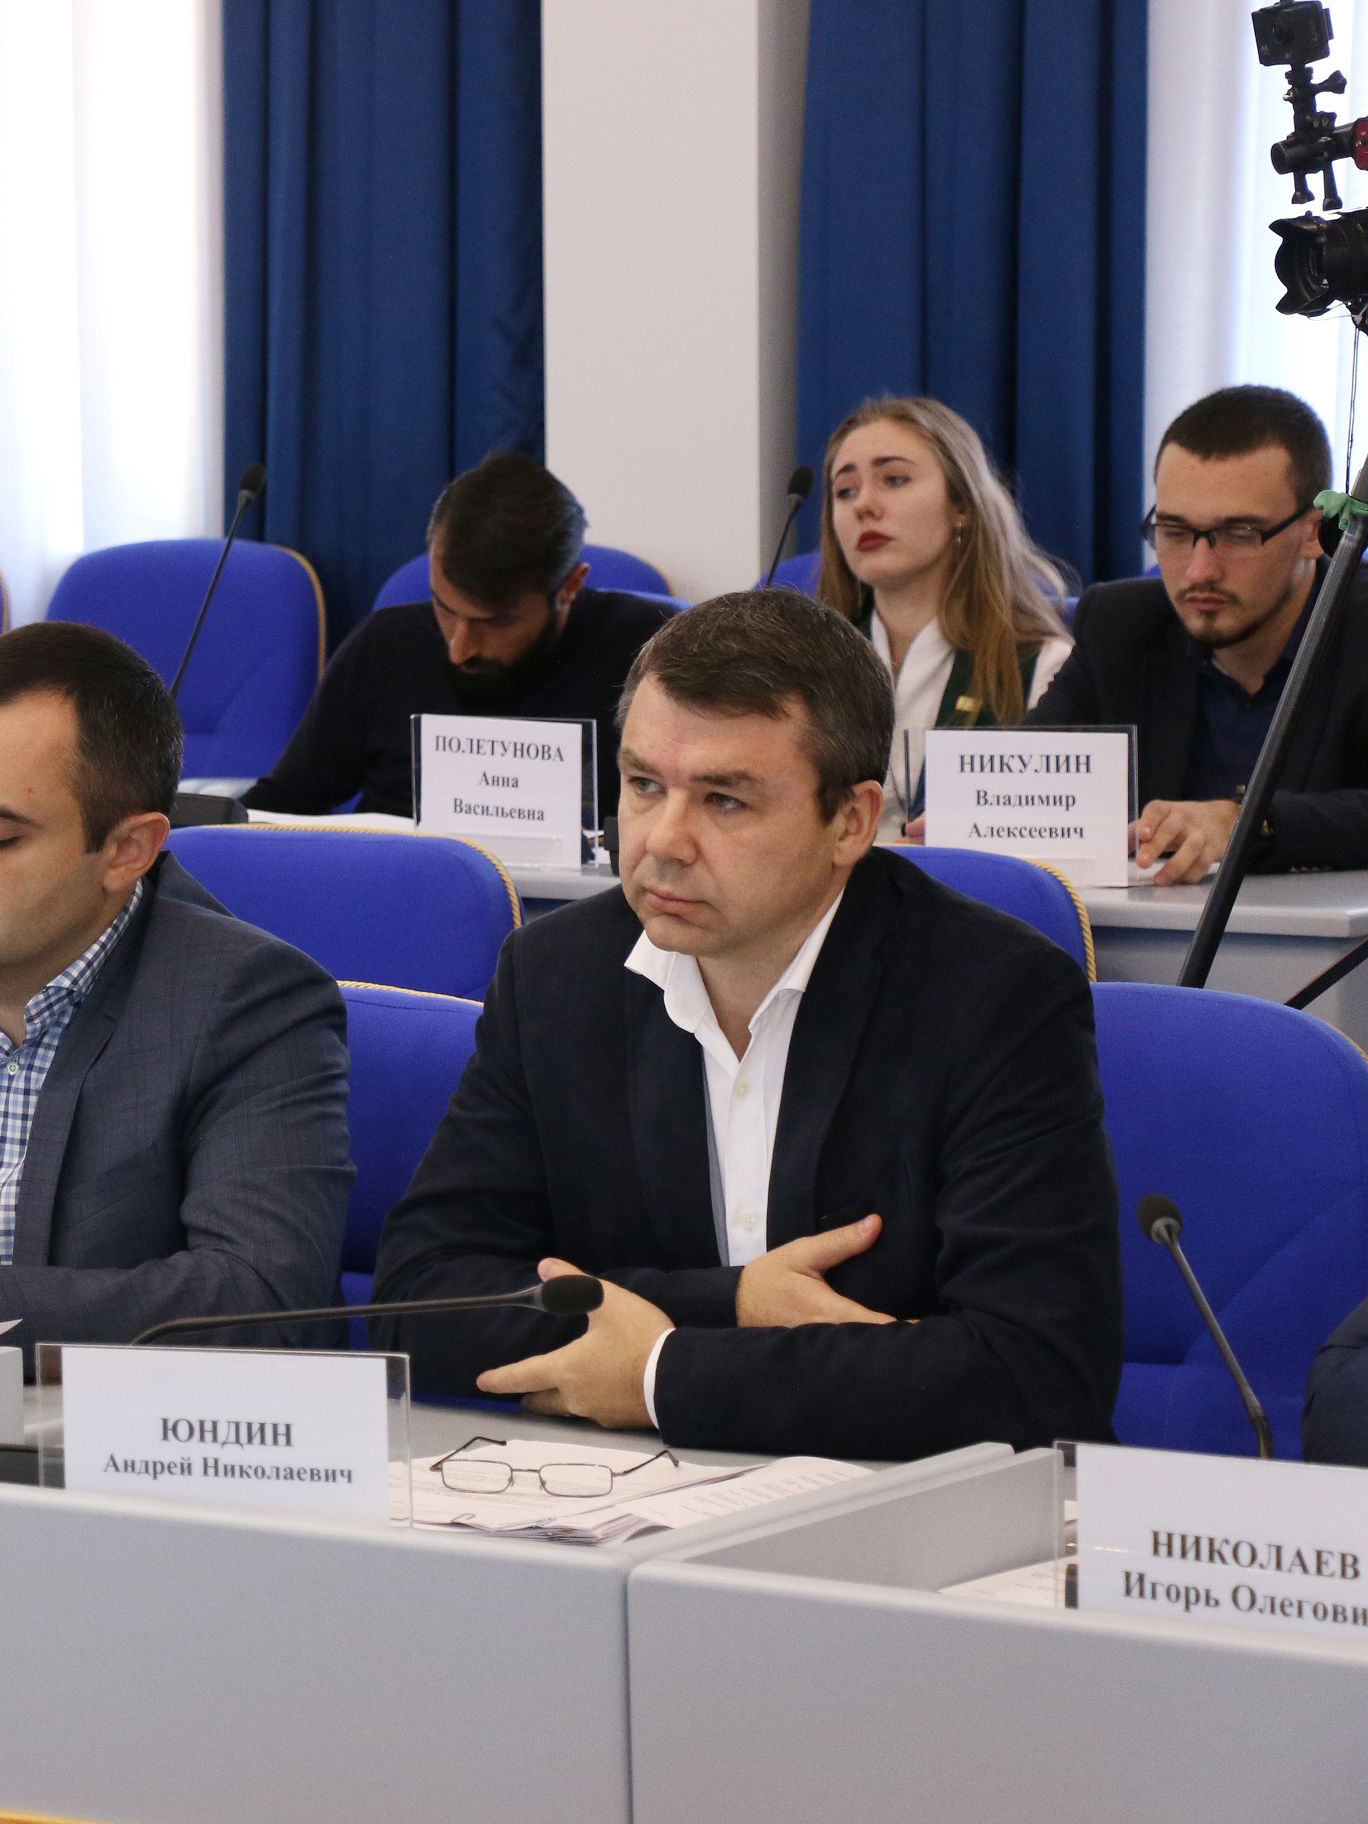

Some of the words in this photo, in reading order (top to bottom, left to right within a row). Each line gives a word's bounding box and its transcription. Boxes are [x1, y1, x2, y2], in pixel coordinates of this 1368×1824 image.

[435, 735, 565, 762] ПОЛЕТУНОВА
[958, 754, 1093, 774] НИКУЛИН
[478, 770, 519, 788] Анна
[453, 798, 545, 821] Васильевна
[975, 789, 1077, 811] Владимир
[968, 822, 1085, 840] Алексеевич
[160, 1417, 294, 1450] ЮНДИН
[103, 1453, 193, 1480] Андрей
[201, 1456, 354, 1485] Николаевич
[1150, 1530, 1362, 1581] НИКОЛАЕВ
[1122, 1570, 1221, 1614] Игорь
